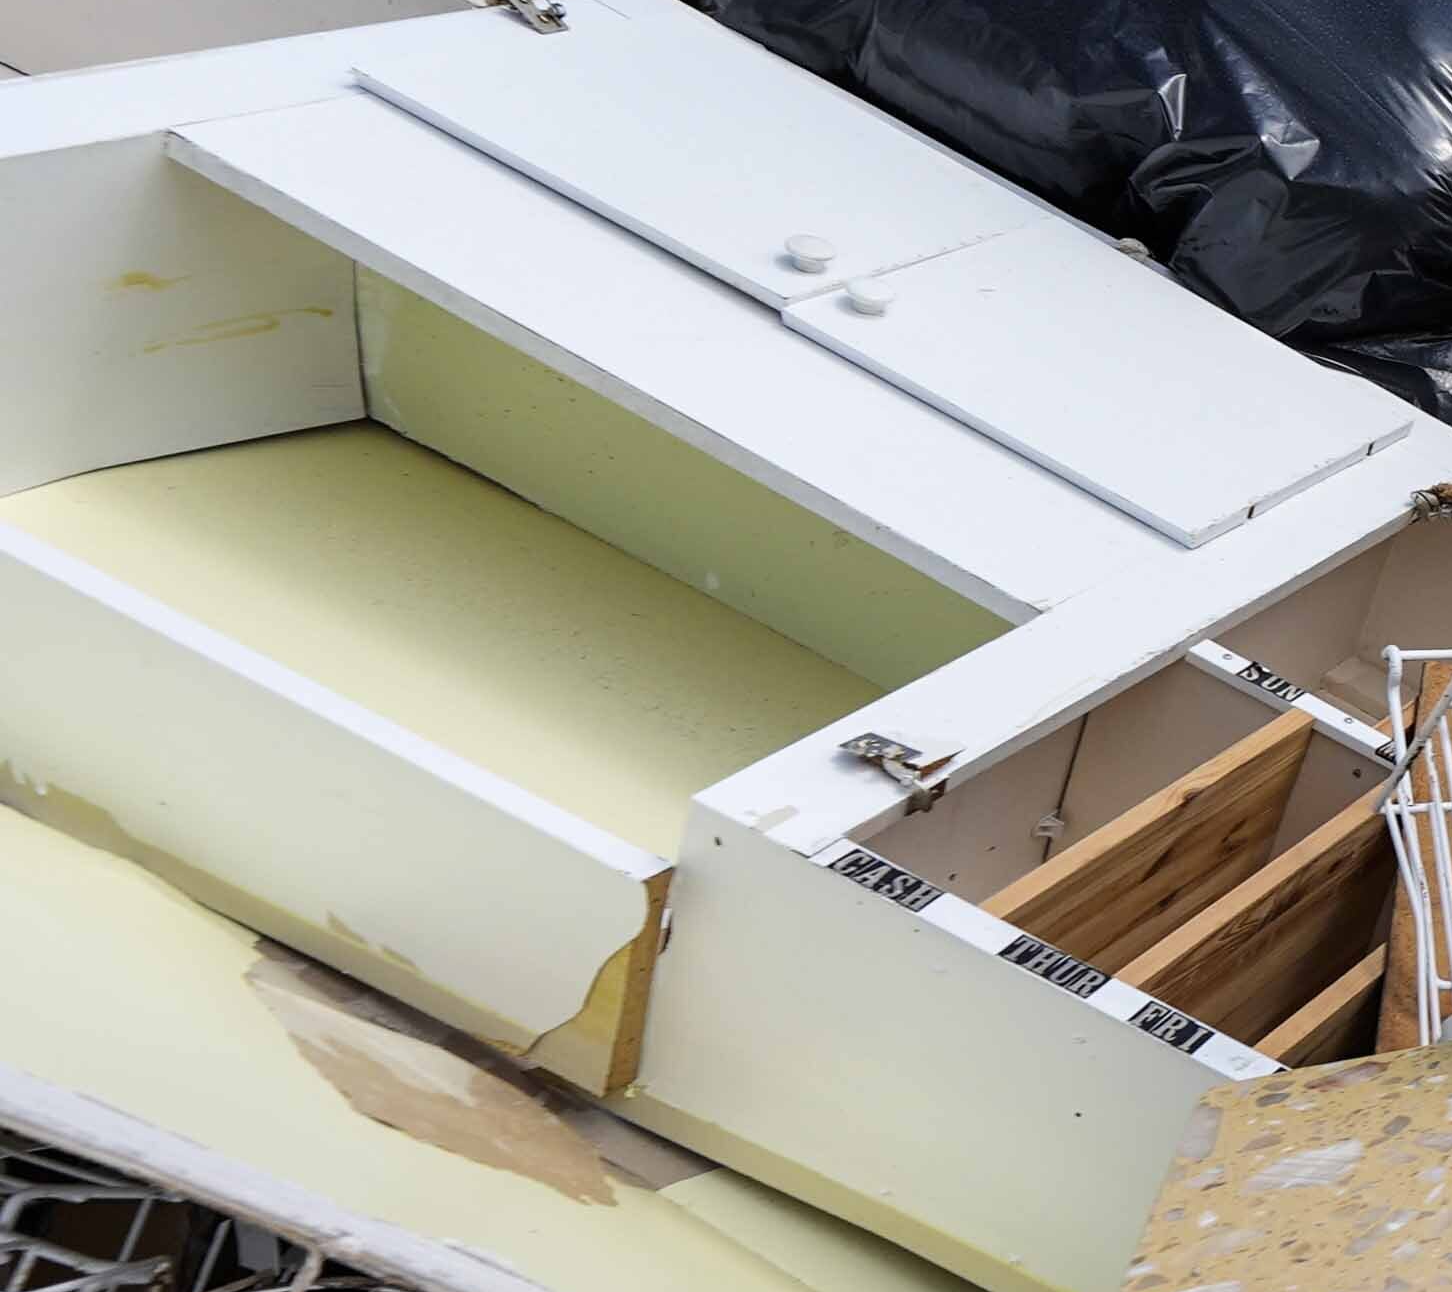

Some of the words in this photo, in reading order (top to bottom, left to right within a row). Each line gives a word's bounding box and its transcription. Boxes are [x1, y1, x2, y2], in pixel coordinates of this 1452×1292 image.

[1240, 666, 1303, 702] SUN
[832, 849, 936, 910] CASH
[1002, 936, 1108, 998] THUR
[1133, 1002, 1208, 1054] FRI
